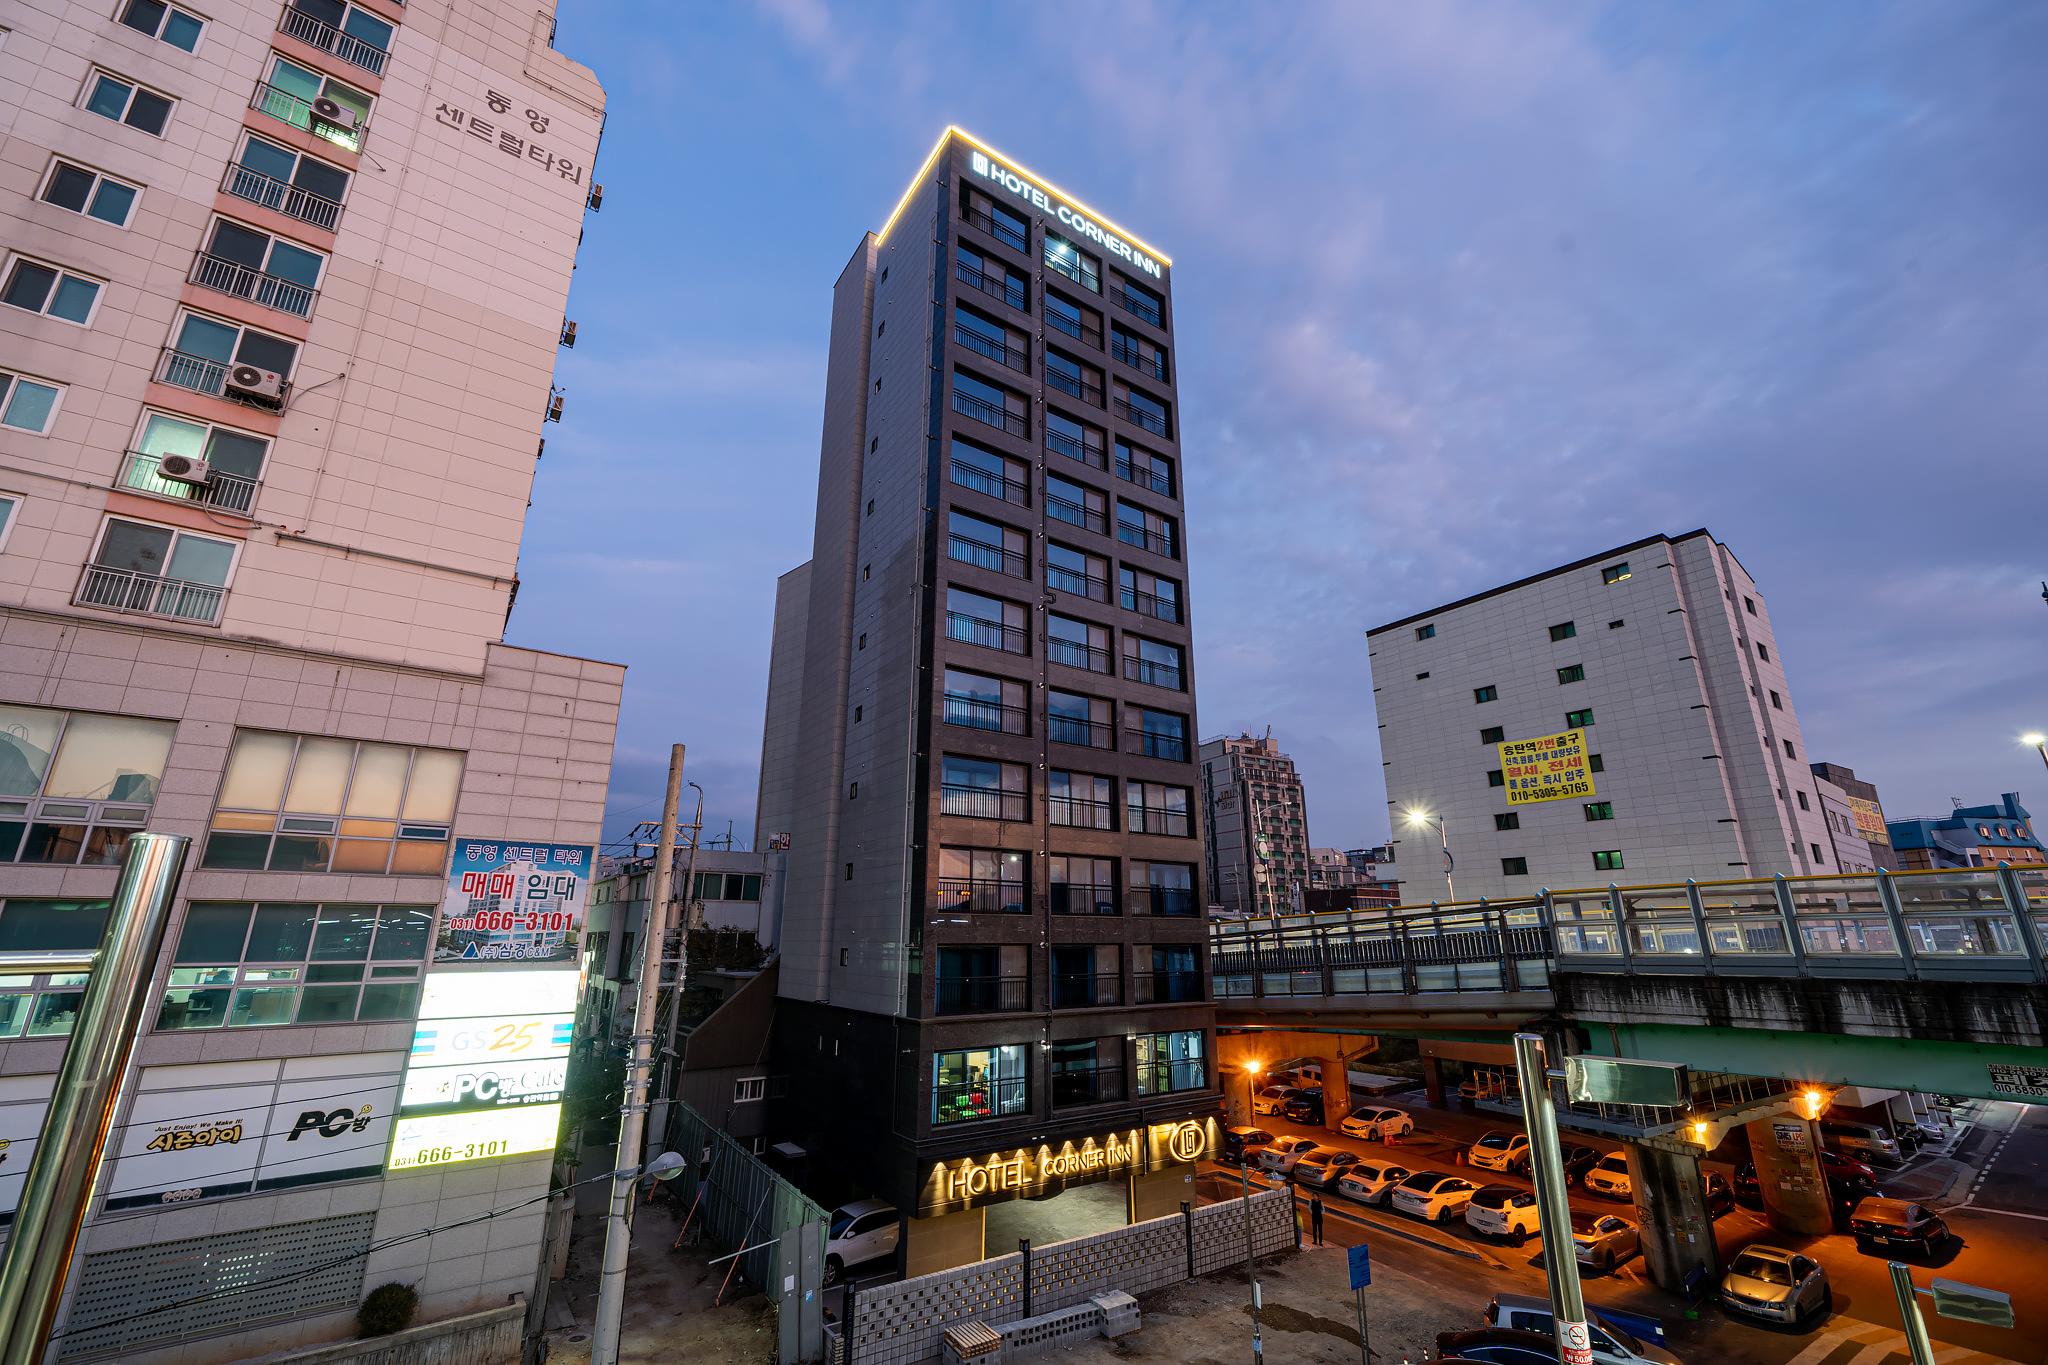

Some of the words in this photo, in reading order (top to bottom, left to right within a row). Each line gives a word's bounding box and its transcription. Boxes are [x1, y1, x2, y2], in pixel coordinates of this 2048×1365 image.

[435, 103, 583, 186] 센트럴타워
[991, 163, 1055, 216] HOTEL
[1057, 206, 1132, 261] CORNER
[1133, 250, 1161, 279] INN
[1548, 755, 1583, 772] 전세
[1565, 768, 1585, 782] 입주
[1511, 781, 1589, 802] 010-5305-5765
[466, 844, 498, 861] 동영
[503, 846, 549, 863] 센트럴
[554, 849, 583, 865] 타워
[461, 872, 515, 899] 매매
[527, 873, 577, 901] 임대
[451, 1021, 543, 1053] GS25
[146, 1124, 242, 1152] 시즌아이
[173, 1123, 197, 1131] Enjoy!
[286, 1108, 371, 1141] PC방
[949, 1161, 1032, 1200] HOTEL
[1043, 1148, 1105, 1176] CORNER
[1107, 1143, 1133, 1165] INN
